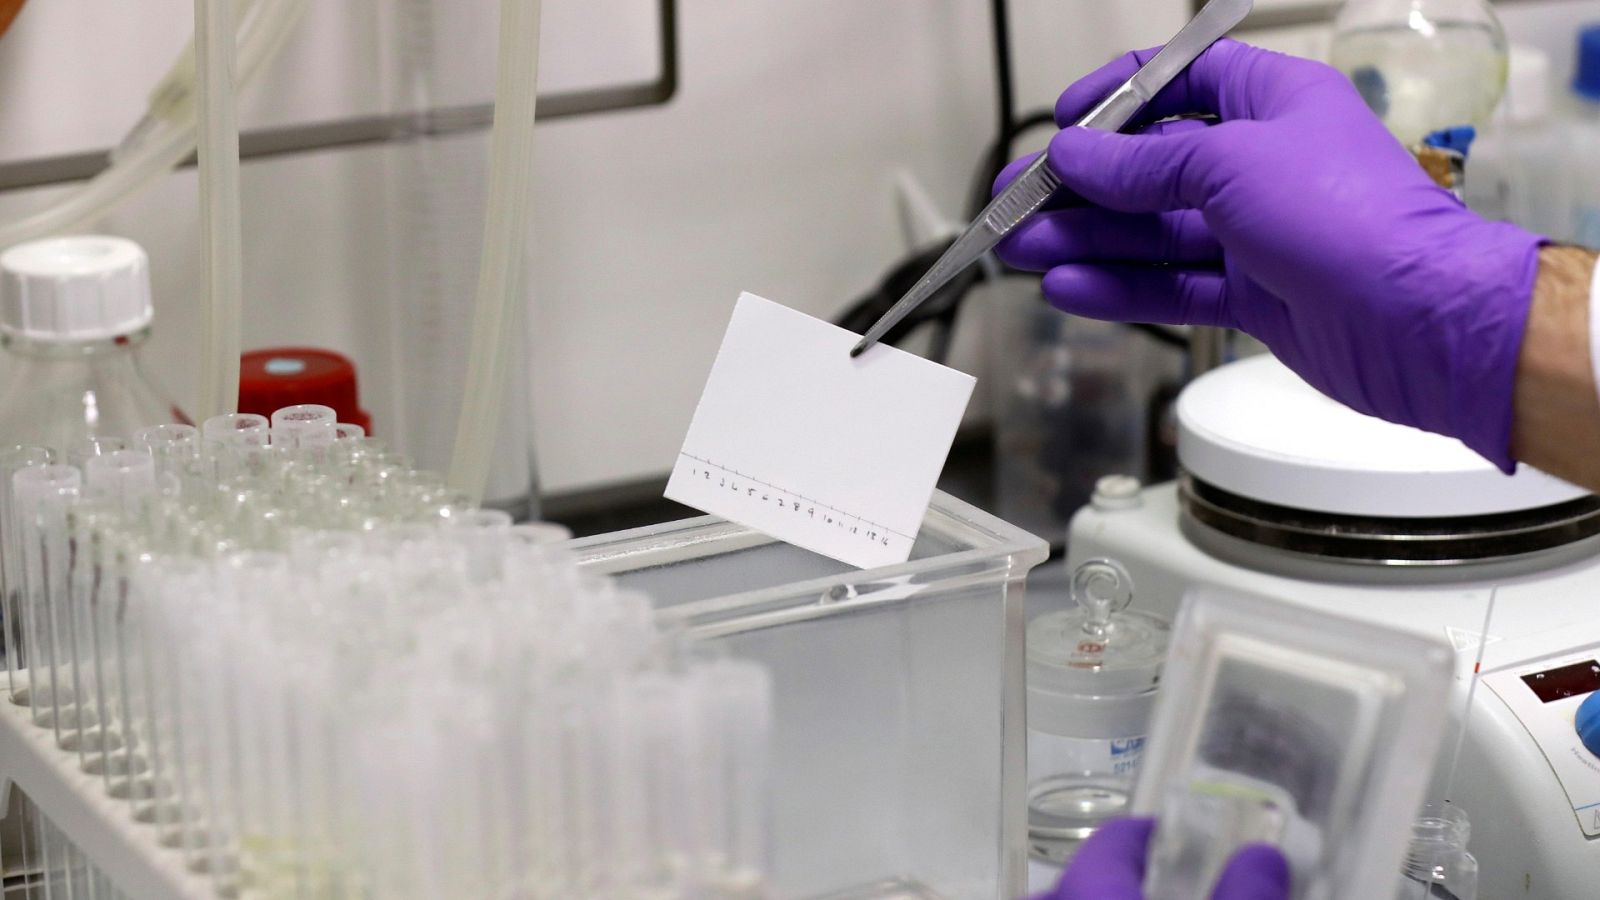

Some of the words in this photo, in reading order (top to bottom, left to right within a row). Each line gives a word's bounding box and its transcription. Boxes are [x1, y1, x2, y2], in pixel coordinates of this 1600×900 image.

[704, 470, 710, 479] 2
[793, 502, 800, 511] 8
[807, 507, 814, 518] 9
